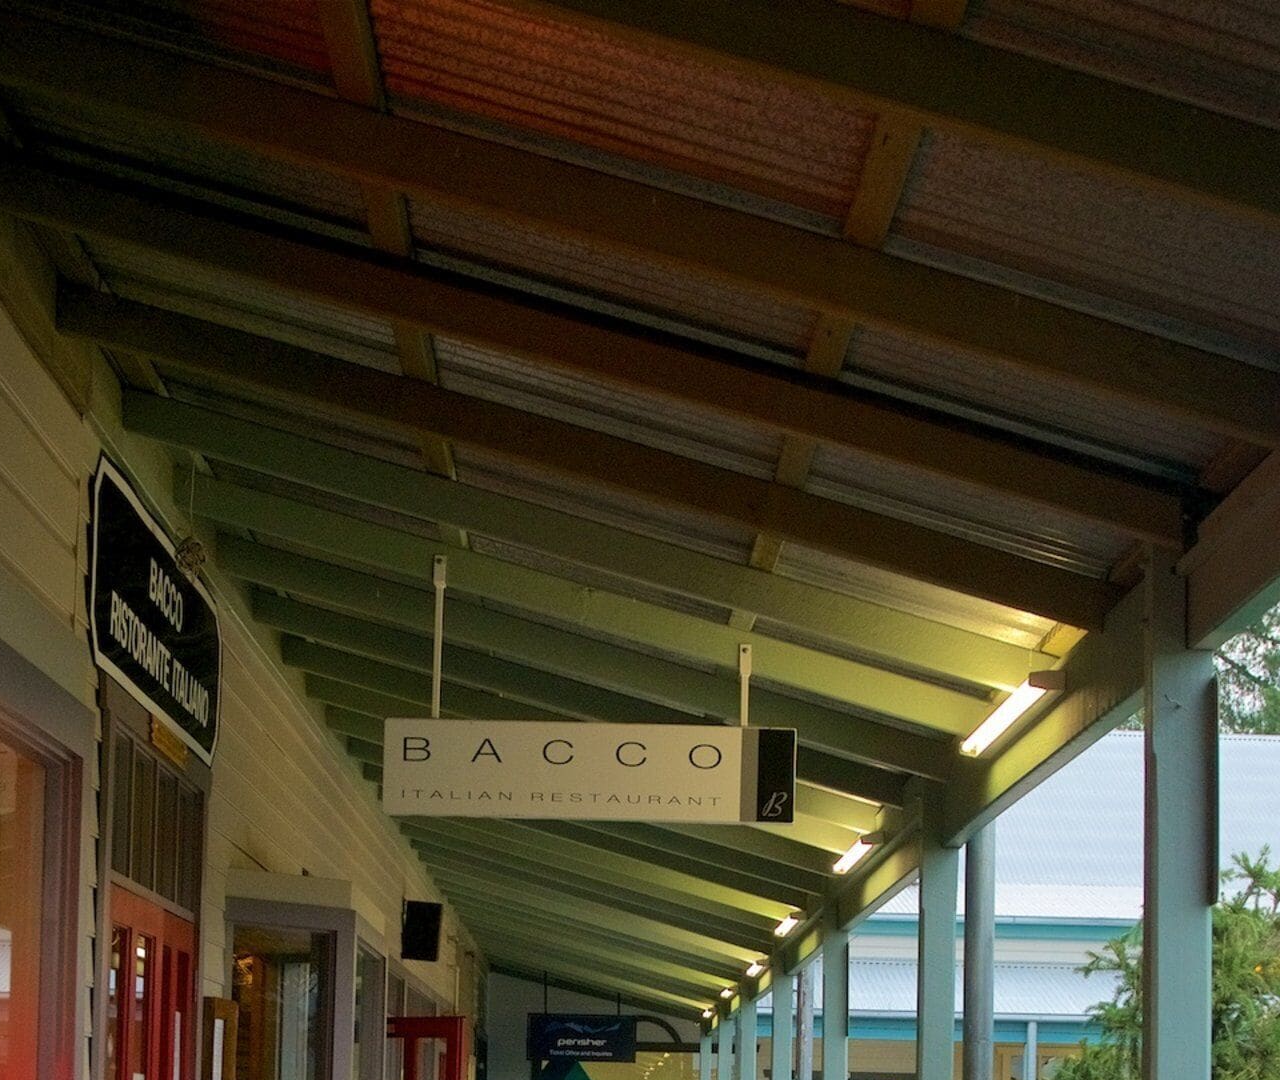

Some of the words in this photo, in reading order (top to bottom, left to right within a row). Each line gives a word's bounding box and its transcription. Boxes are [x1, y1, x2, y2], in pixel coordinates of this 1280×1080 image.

[150, 556, 183, 632] BACCO
[110, 590, 171, 689] RISTORANTE
[172, 658, 209, 727] ITALIANO
[403, 737, 723, 769] BACCO
[402, 790, 513, 801] ITALIAN
[531, 792, 722, 807] RESTAURANT
[557, 1038, 607, 1047] perisher
